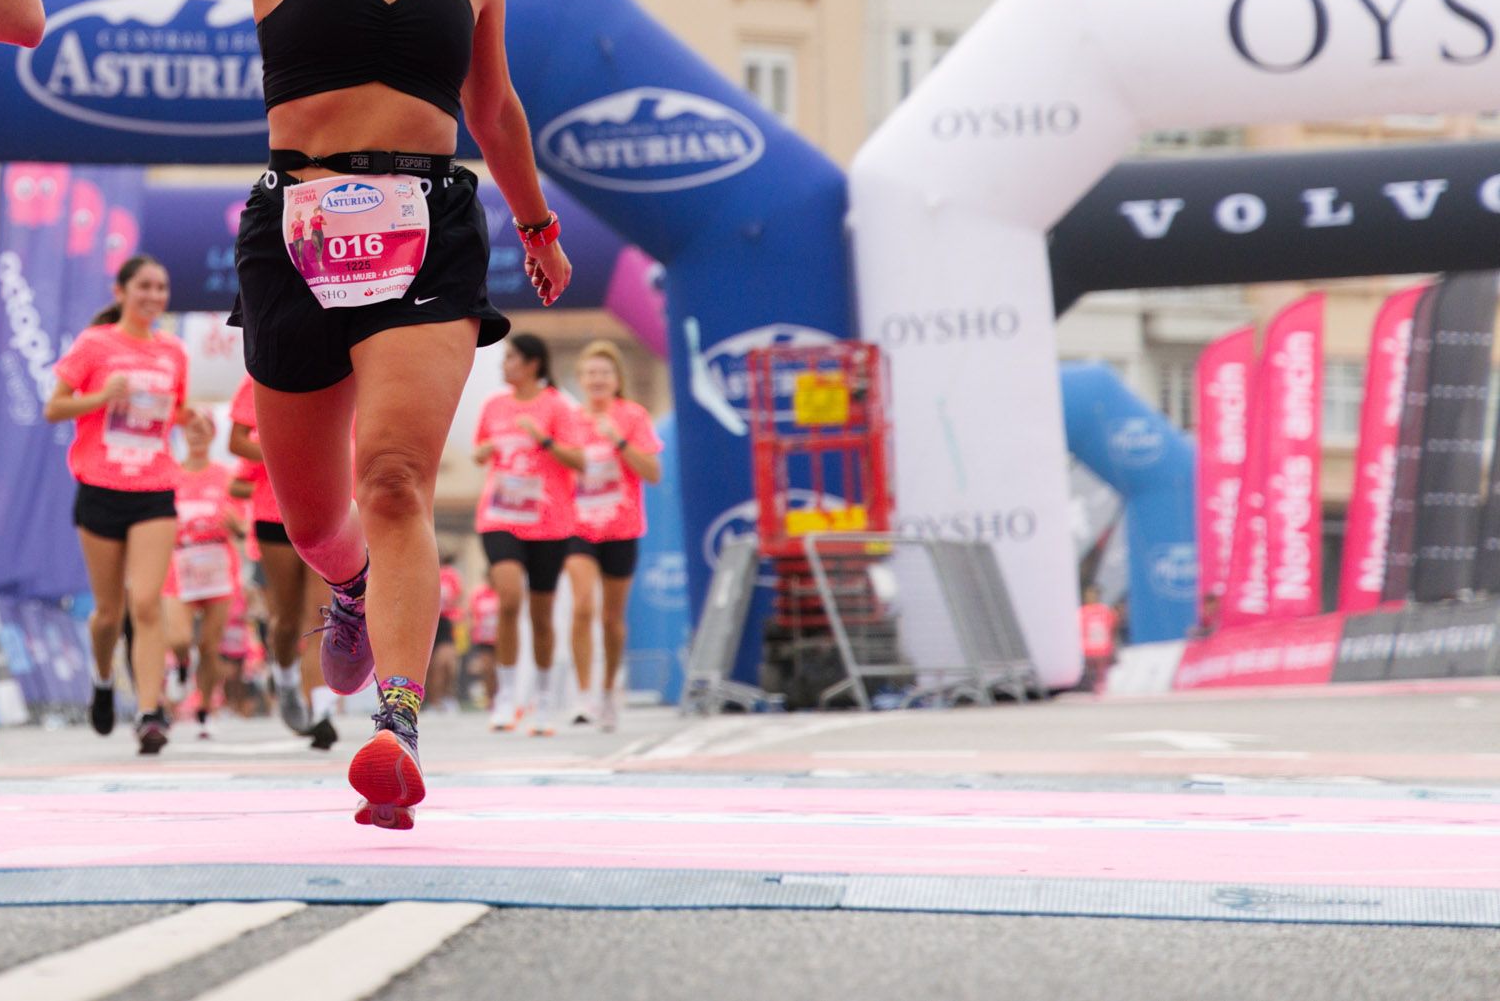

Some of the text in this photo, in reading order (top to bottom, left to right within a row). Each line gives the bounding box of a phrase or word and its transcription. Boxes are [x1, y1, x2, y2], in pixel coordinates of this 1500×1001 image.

[931, 101, 1080, 142] OYSHO
[558, 128, 750, 170] ASTURIANA
[294, 193, 318, 205] SUMA
[325, 195, 380, 208] ASTURIANA
[328, 233, 384, 259] 016
[345, 260, 372, 272] 1225
[330, 275, 340, 283] DE
[341, 274, 352, 282] LA
[352, 272, 377, 281] MUJER
[382, 270, 388, 278] A
[881, 303, 1021, 348] OYSHO
